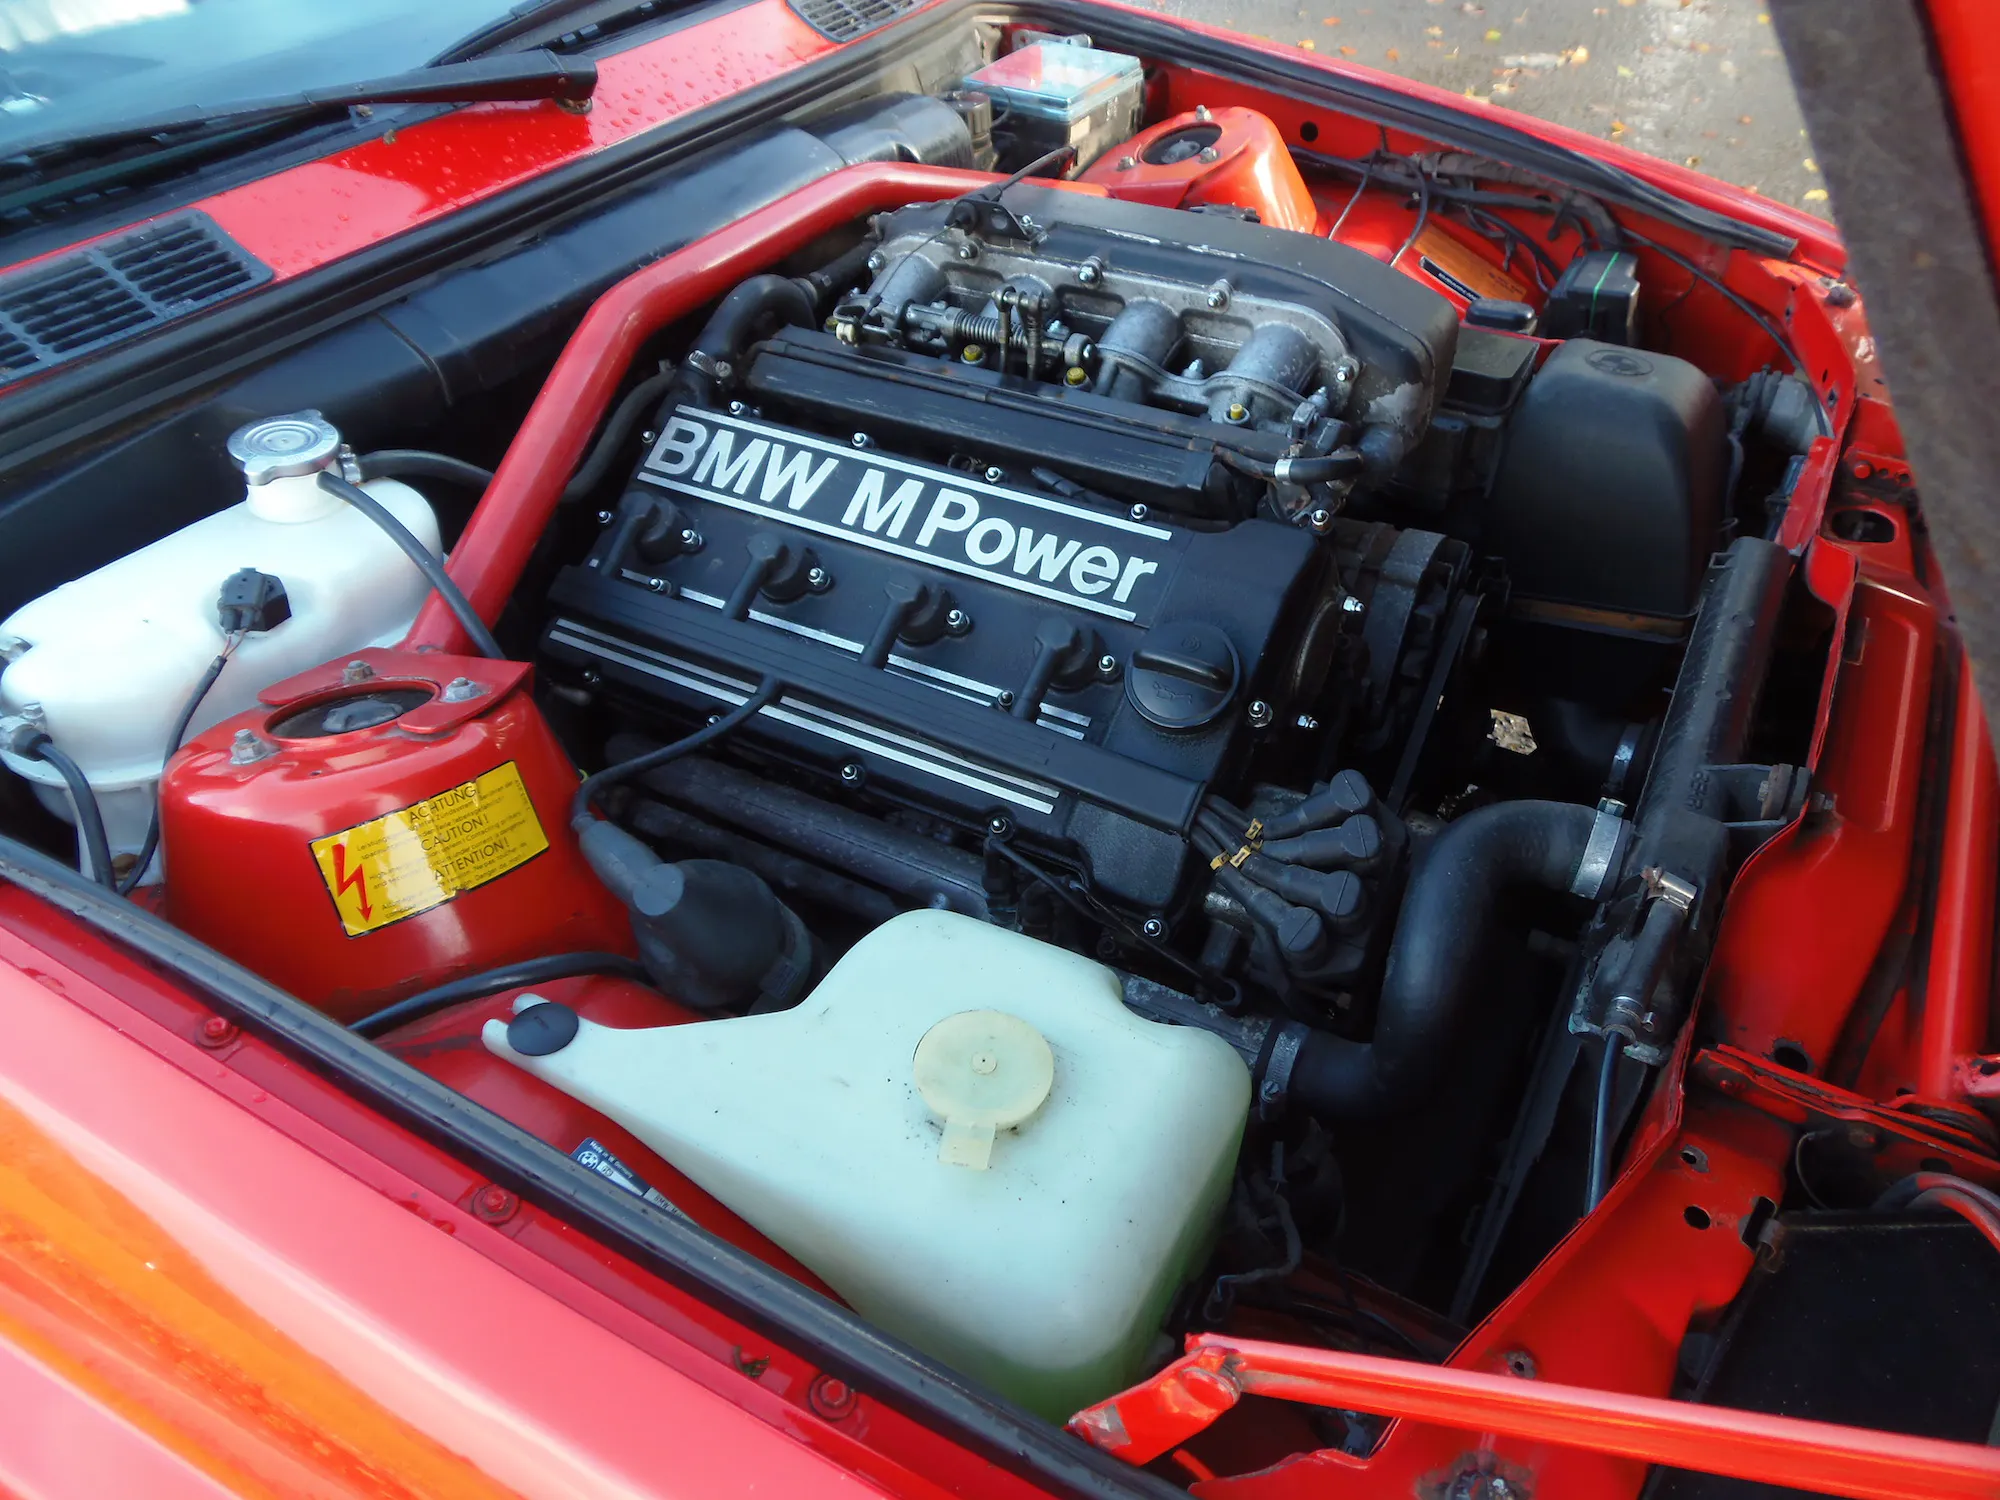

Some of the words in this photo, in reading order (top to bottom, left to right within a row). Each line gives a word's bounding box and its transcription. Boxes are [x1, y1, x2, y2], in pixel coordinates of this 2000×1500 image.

[643, 415, 840, 512] BMW
[842, 468, 926, 540] M
[915, 490, 1160, 604] Power
